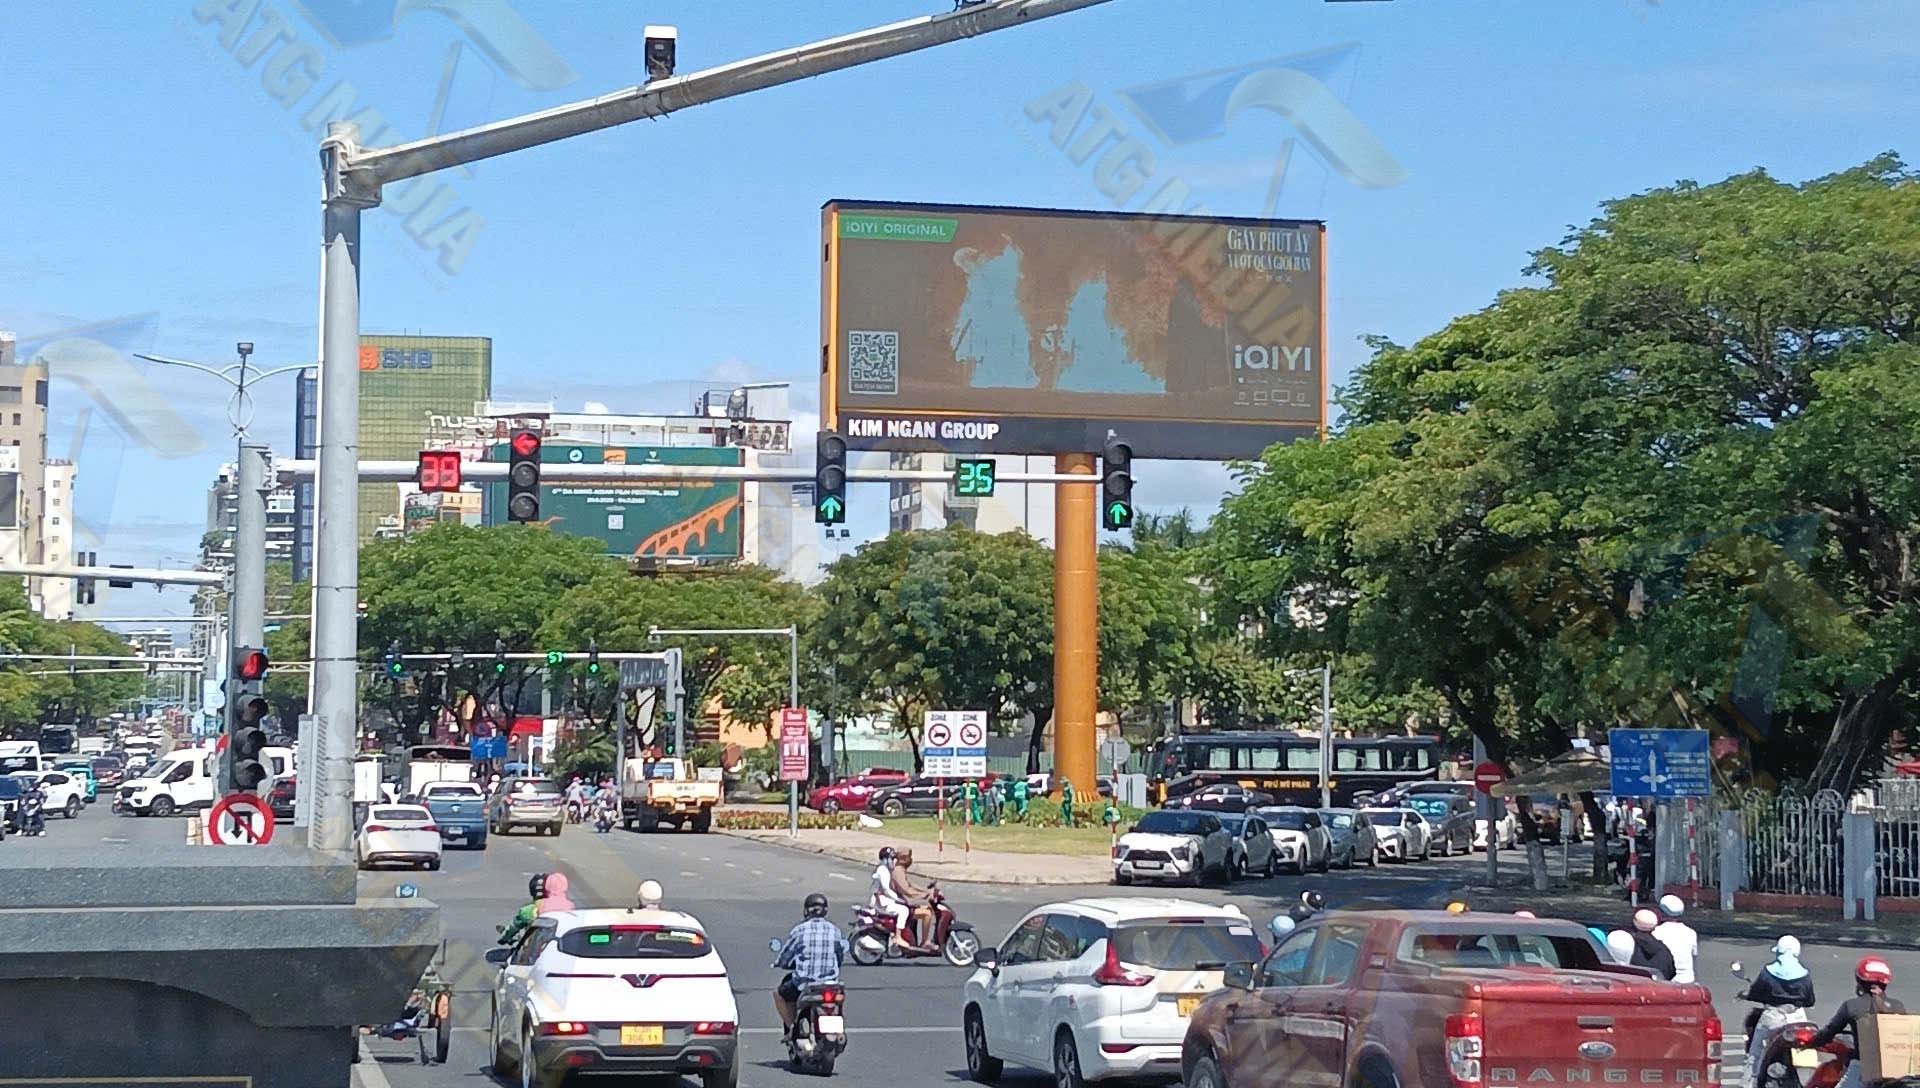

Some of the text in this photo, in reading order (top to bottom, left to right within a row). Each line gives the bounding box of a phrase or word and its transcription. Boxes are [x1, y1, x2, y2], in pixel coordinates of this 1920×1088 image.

[883, 223, 946, 236] ORIGINAL
[382, 349, 433, 369] SHB
[1234, 345, 1312, 371] iQIYI
[848, 419, 999, 440] KIM NGAN GROUP
[959, 463, 993, 494] 35
[1491, 1066, 1699, 1083] RANGER
